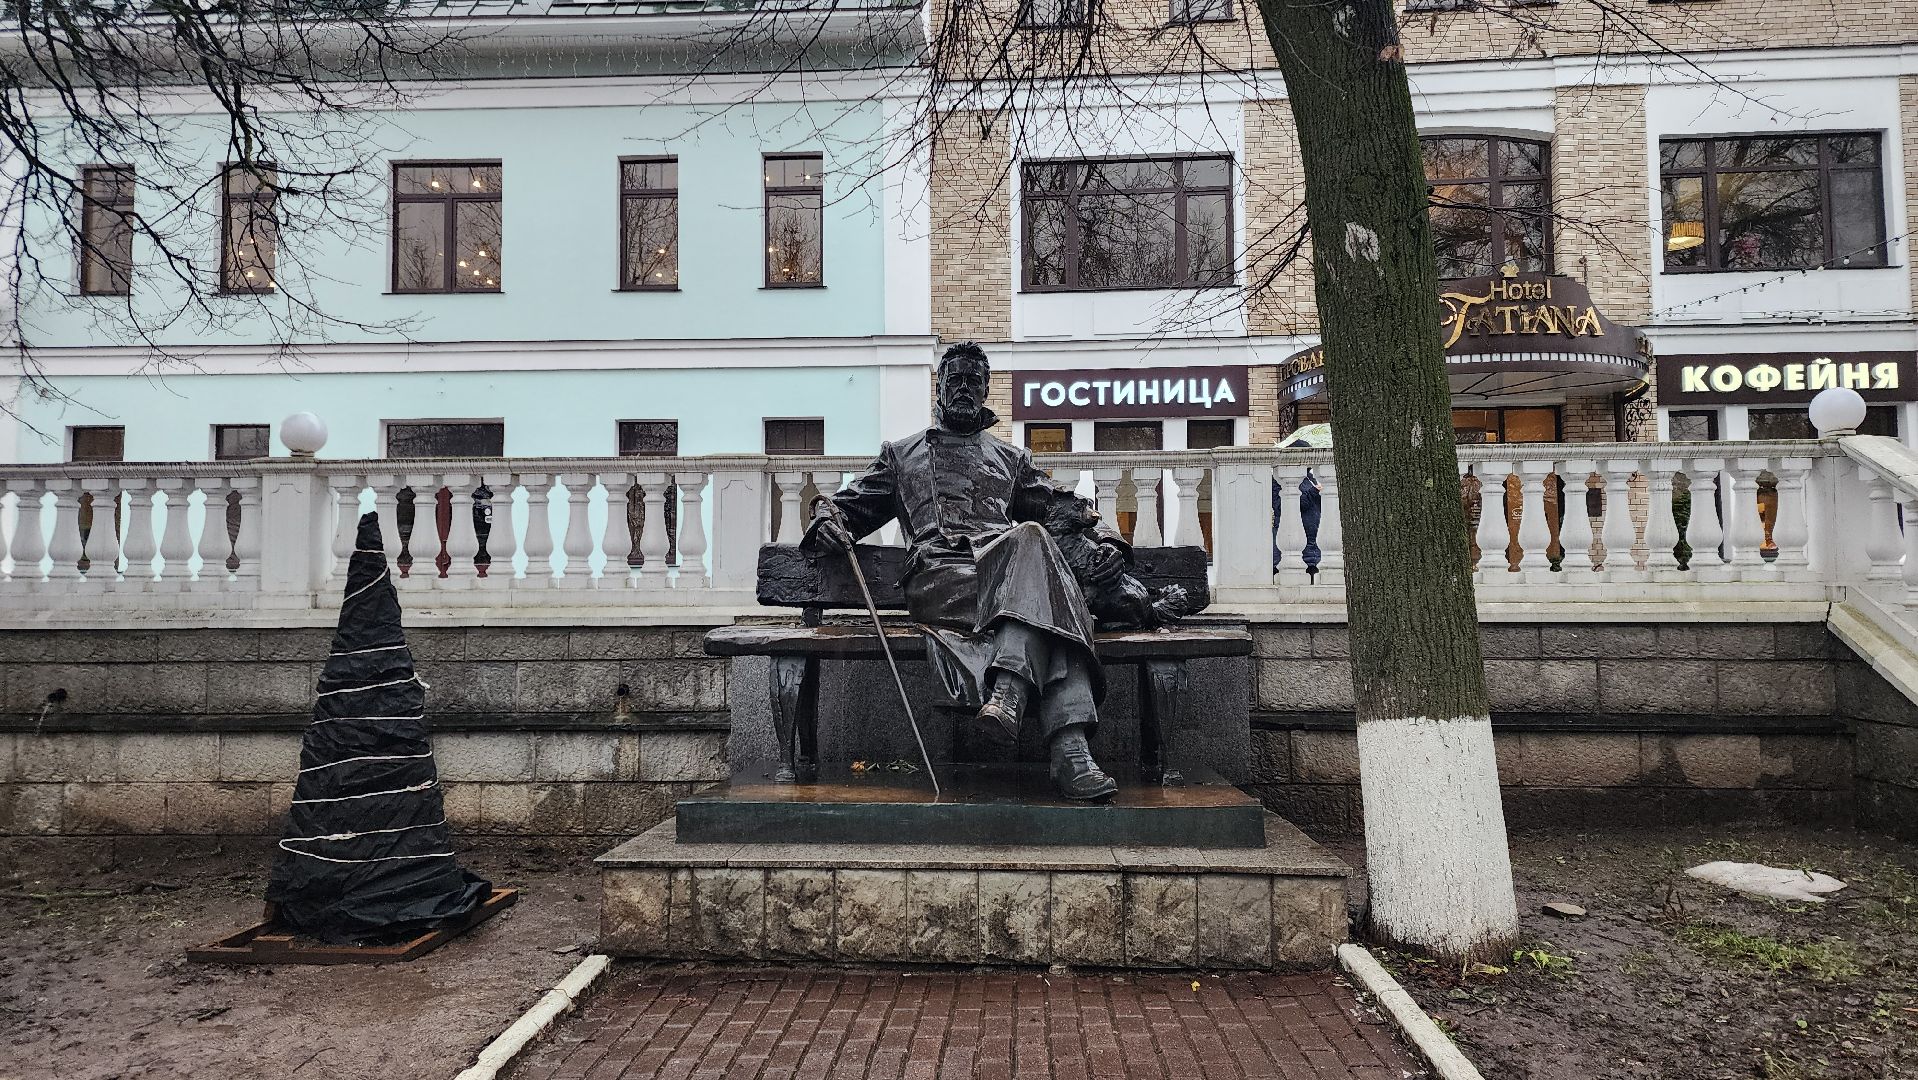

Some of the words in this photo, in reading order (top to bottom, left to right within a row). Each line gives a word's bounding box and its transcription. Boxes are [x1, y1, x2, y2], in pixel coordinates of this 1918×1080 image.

[1490, 279, 1552, 300] Hotel
[1681, 357, 1899, 393] КОФЕЙНЯ
[1024, 377, 1236, 408] ГОСТИНИЦА
